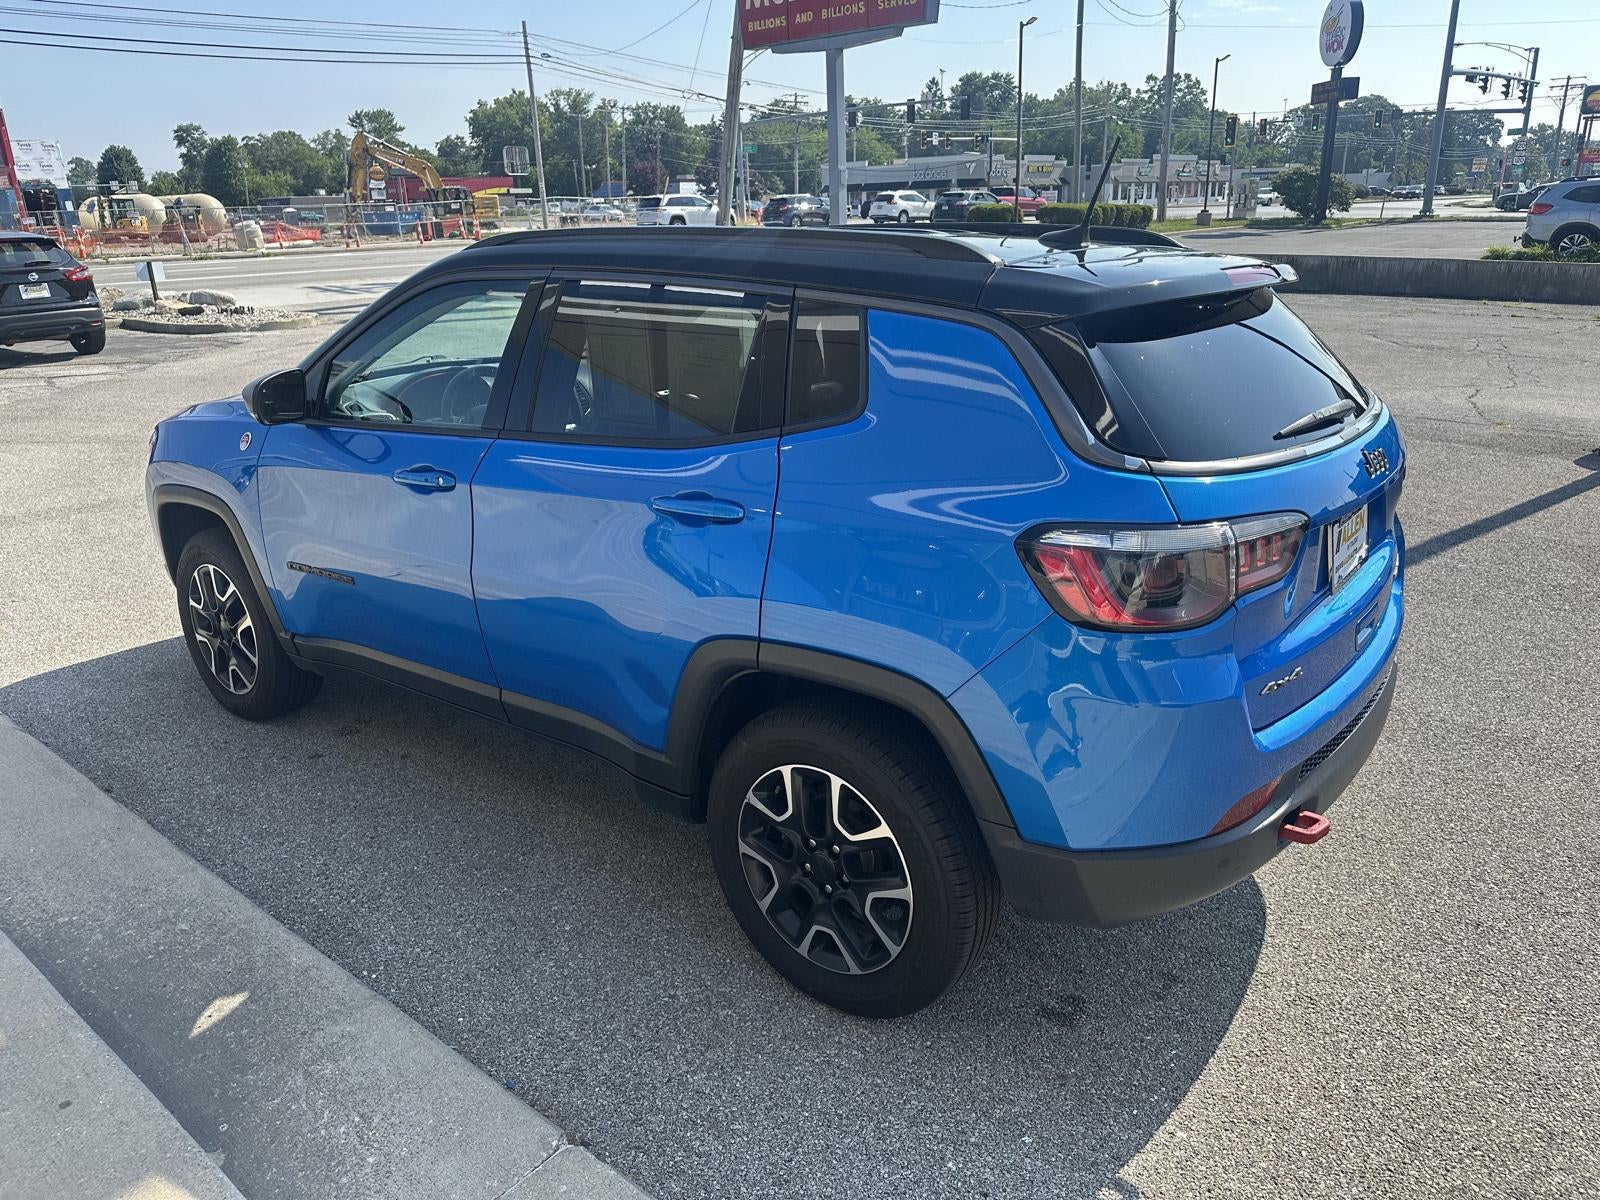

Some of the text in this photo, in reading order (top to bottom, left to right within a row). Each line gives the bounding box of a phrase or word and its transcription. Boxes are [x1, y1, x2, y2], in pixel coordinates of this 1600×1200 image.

[747, 16, 787, 32] BILLIONS
[795, 13, 814, 24] AND
[821, 2, 865, 19] BILLIONS
[1325, 38, 1345, 54] WOK
[1360, 448, 1389, 479] Jeep
[1341, 510, 1365, 544] ALLEN
